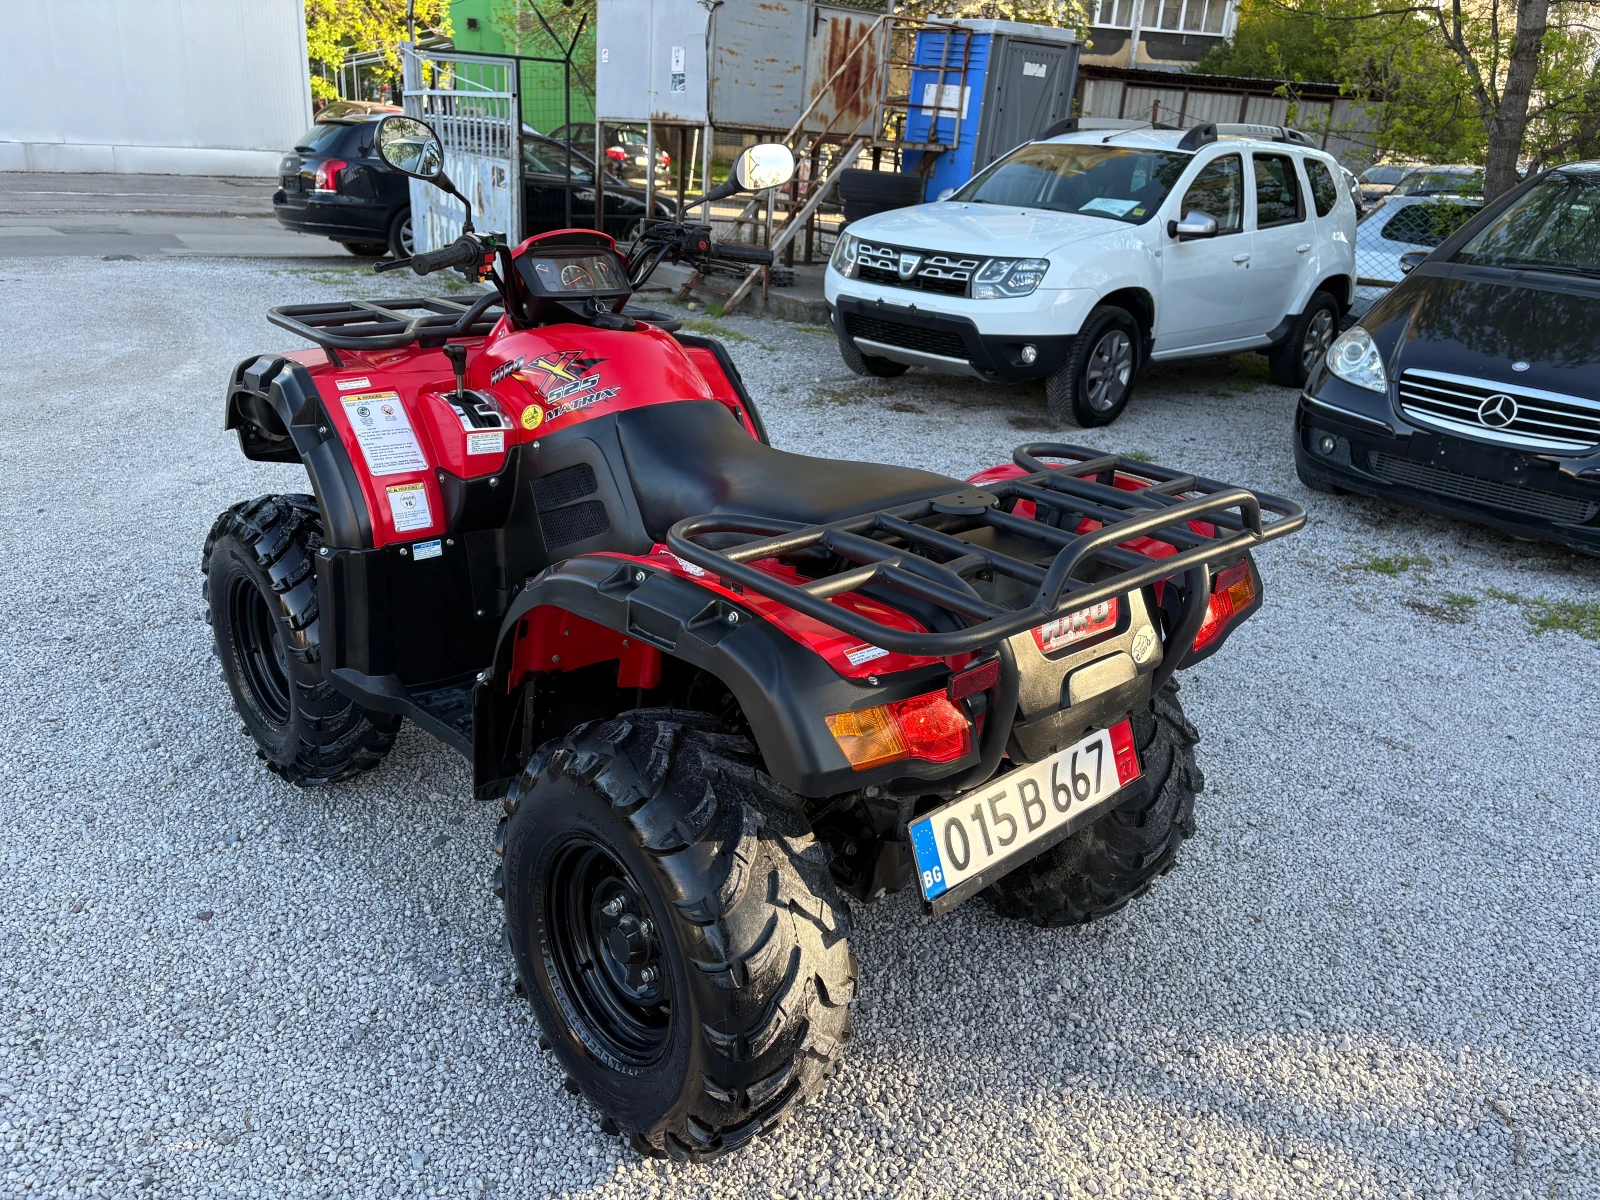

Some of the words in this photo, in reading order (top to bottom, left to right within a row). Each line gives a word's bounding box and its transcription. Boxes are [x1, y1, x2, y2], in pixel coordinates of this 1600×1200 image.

[1246, 125, 1281, 135] DUSTER
[545, 386, 621, 422] MATRIX
[547, 373, 600, 404] 525
[1041, 600, 1110, 643] HIRO
[944, 790, 1018, 872] 015
[1016, 777, 1047, 833] B
[1050, 739, 1104, 813] 667
[923, 865, 942, 889] BG
